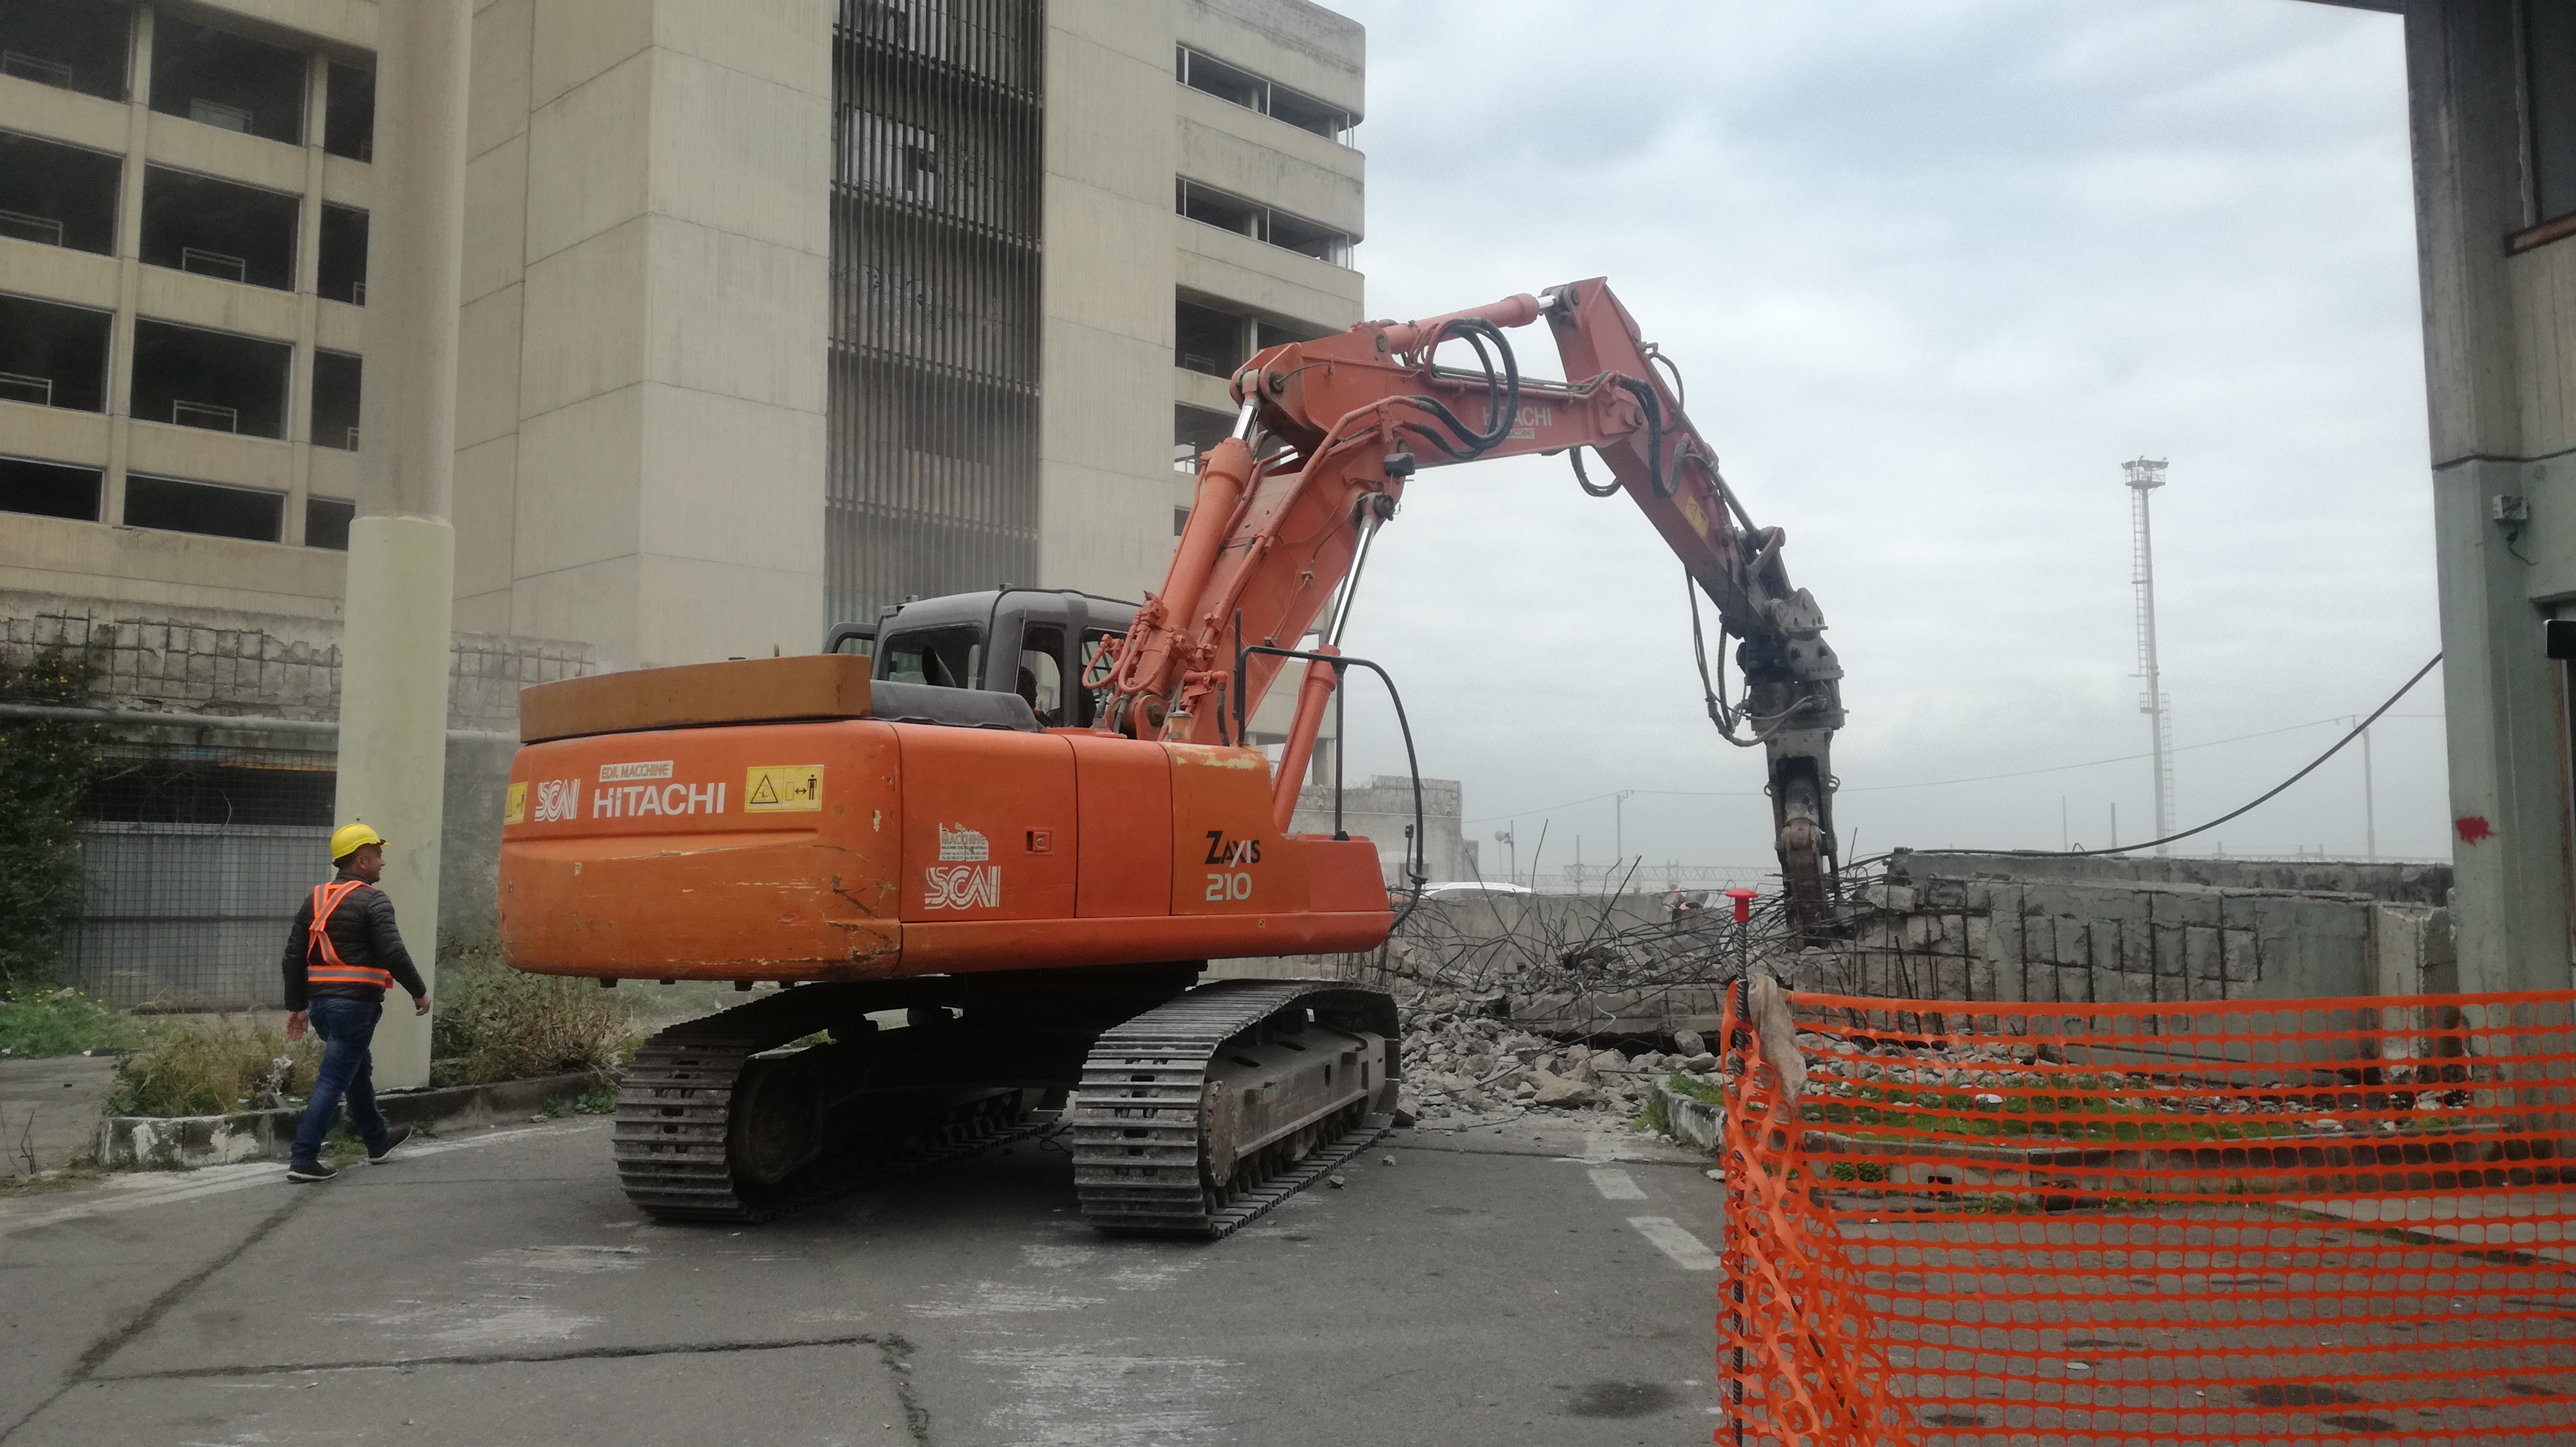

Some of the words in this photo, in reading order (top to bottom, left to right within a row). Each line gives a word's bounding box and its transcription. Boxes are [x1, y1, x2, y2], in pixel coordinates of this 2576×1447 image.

[1482, 406, 1552, 426] HACHI
[601, 766, 619, 779] EDIL
[621, 763, 669, 778] MACCHINE
[593, 782, 726, 818] HITACHI
[1206, 872, 1252, 901] 210
